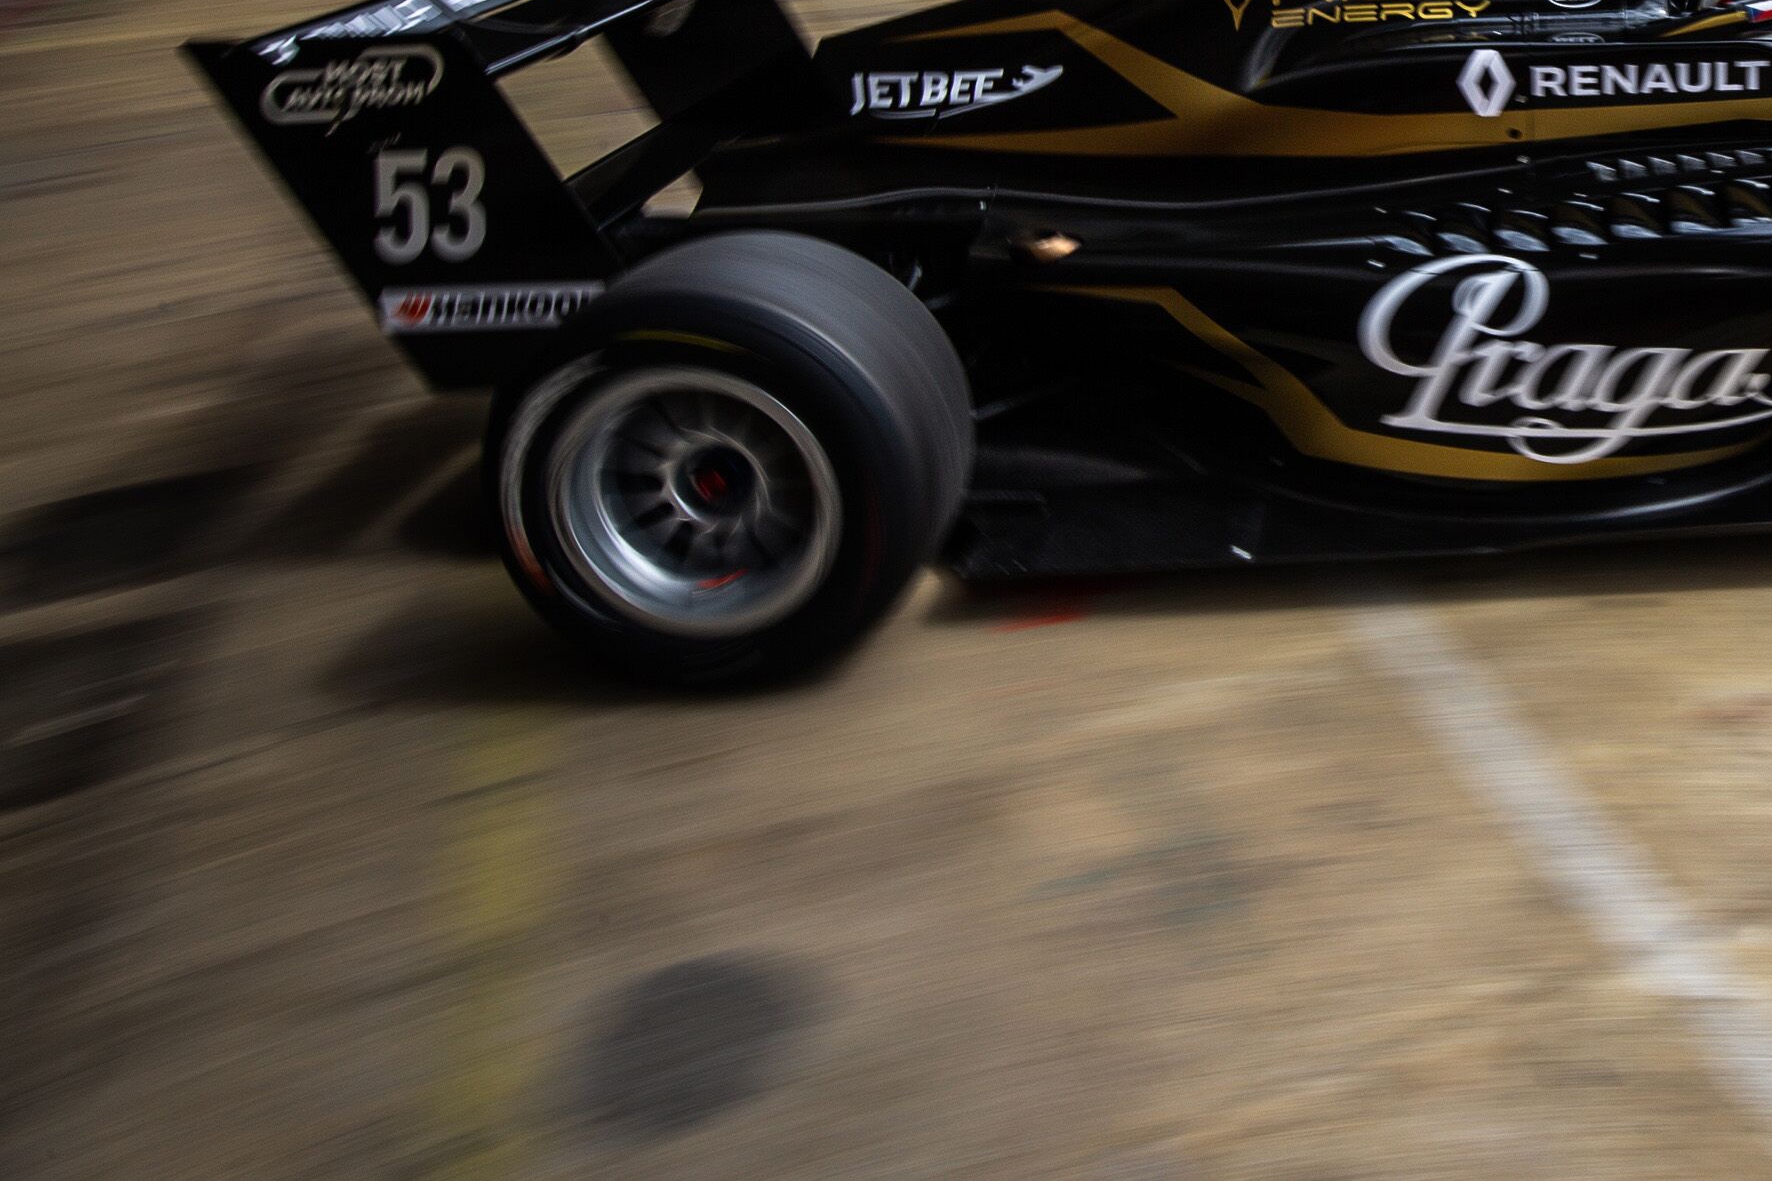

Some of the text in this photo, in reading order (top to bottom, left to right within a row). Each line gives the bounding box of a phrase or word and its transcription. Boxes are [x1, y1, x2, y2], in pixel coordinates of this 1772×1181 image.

[1270, 0, 1491, 28] ENERGY
[850, 67, 1004, 116] JETBEE
[1529, 59, 1772, 98] RENAULT
[373, 145, 487, 265] 53
